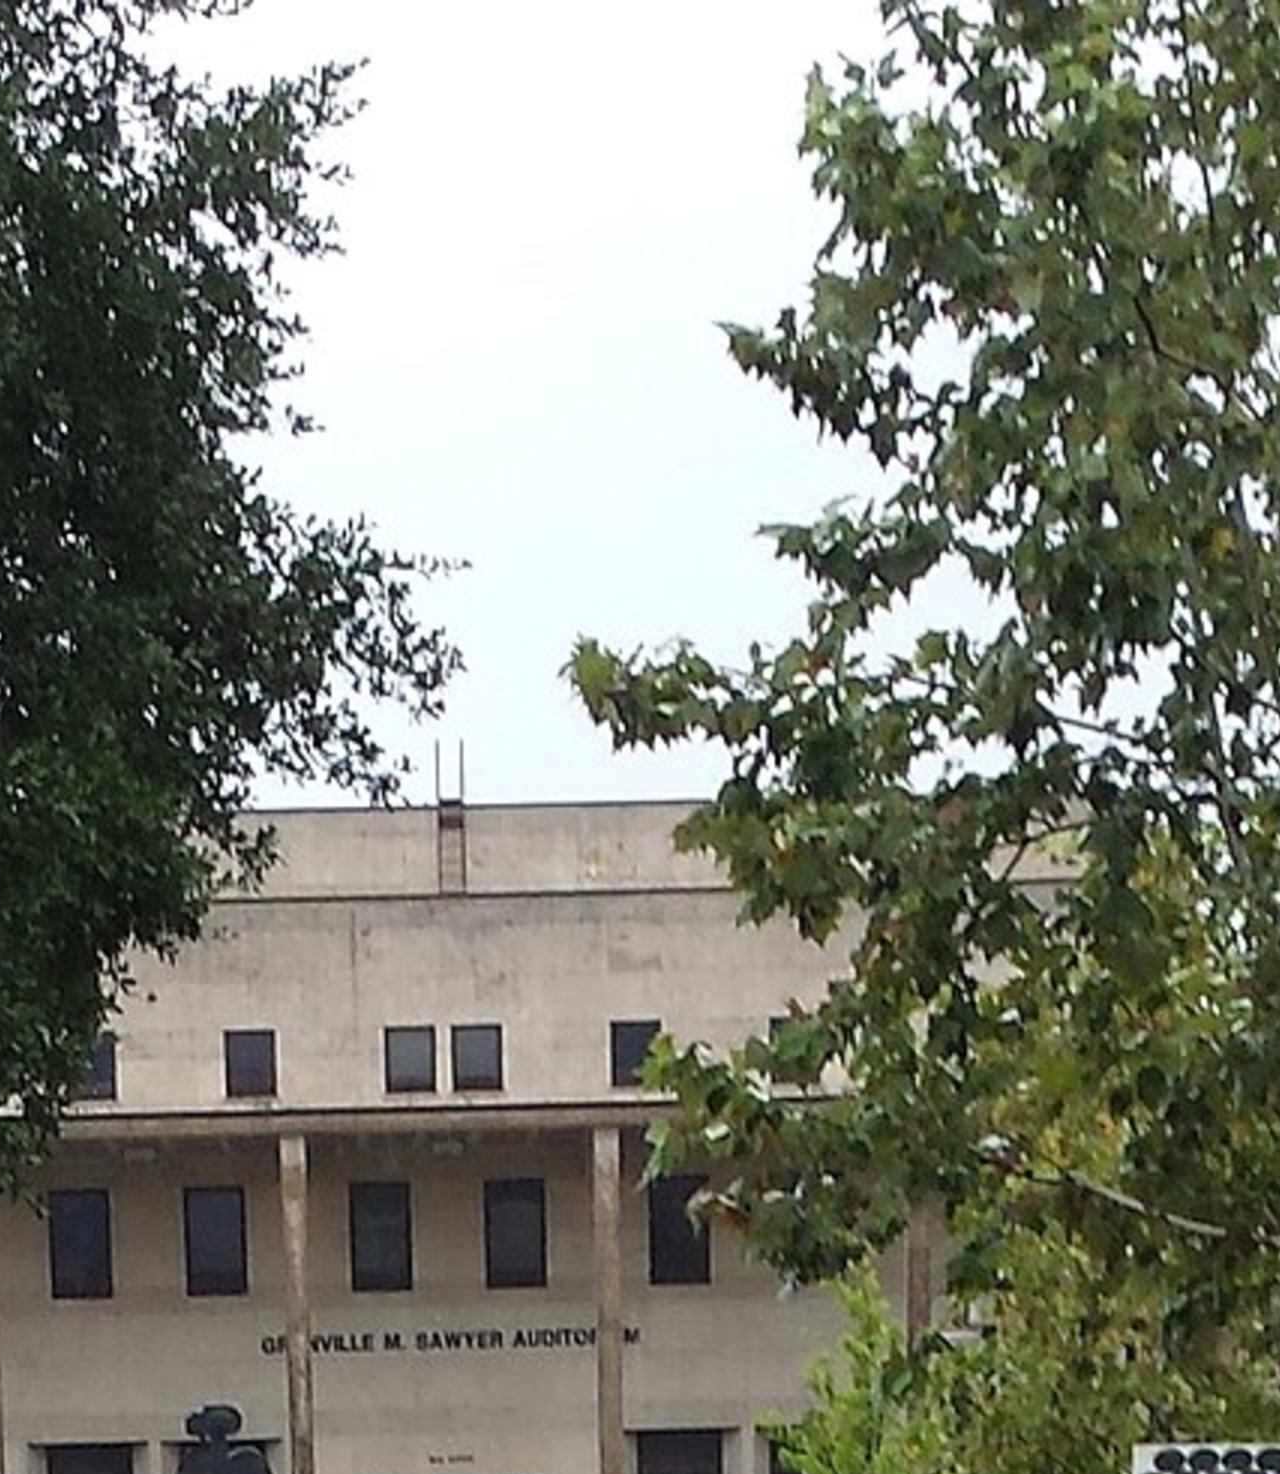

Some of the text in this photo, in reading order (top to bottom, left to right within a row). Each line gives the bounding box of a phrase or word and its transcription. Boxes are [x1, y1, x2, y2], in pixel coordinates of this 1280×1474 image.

[261, 1333, 373, 1354] GRNVILLE
[384, 1332, 405, 1350] M.
[416, 1330, 503, 1350] SAWYER
